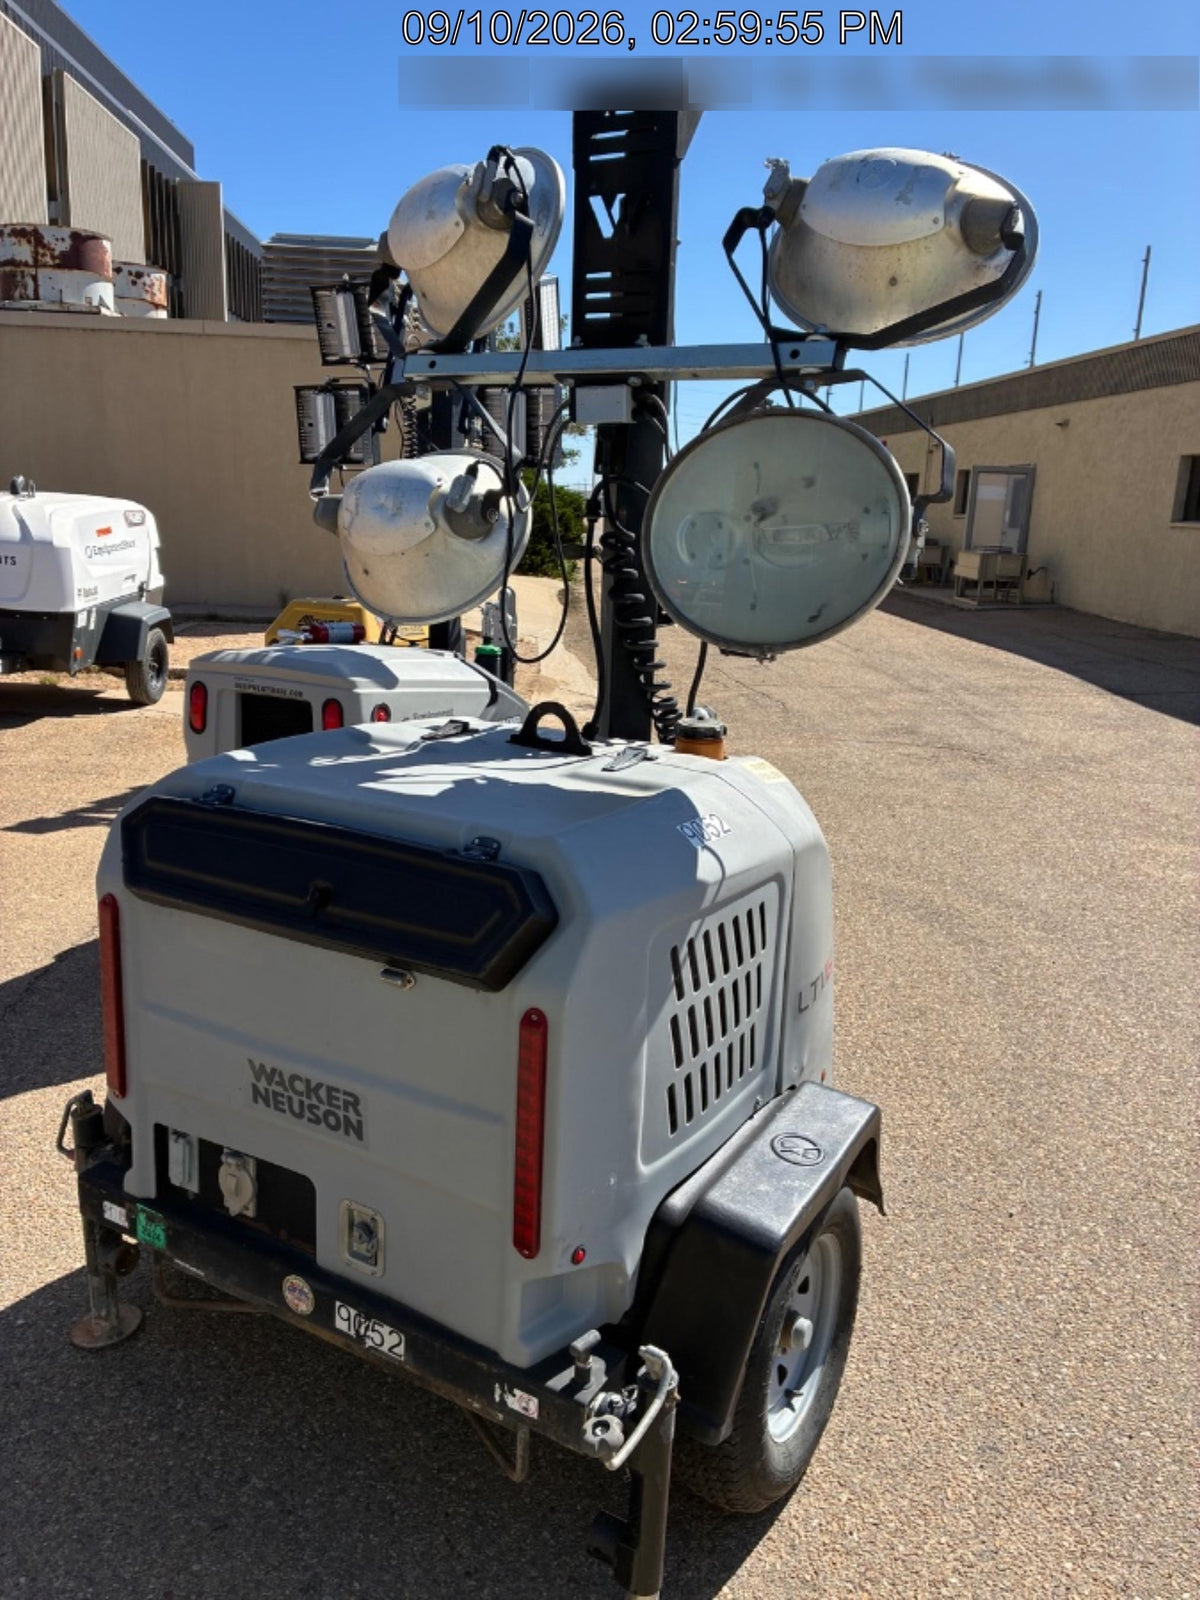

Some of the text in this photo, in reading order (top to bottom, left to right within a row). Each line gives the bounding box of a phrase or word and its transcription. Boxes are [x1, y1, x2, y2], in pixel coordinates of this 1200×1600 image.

[0, 555, 16, 566] TS
[247, 1058, 363, 1118] WACKER
[251, 1082, 364, 1141] NEUSON
